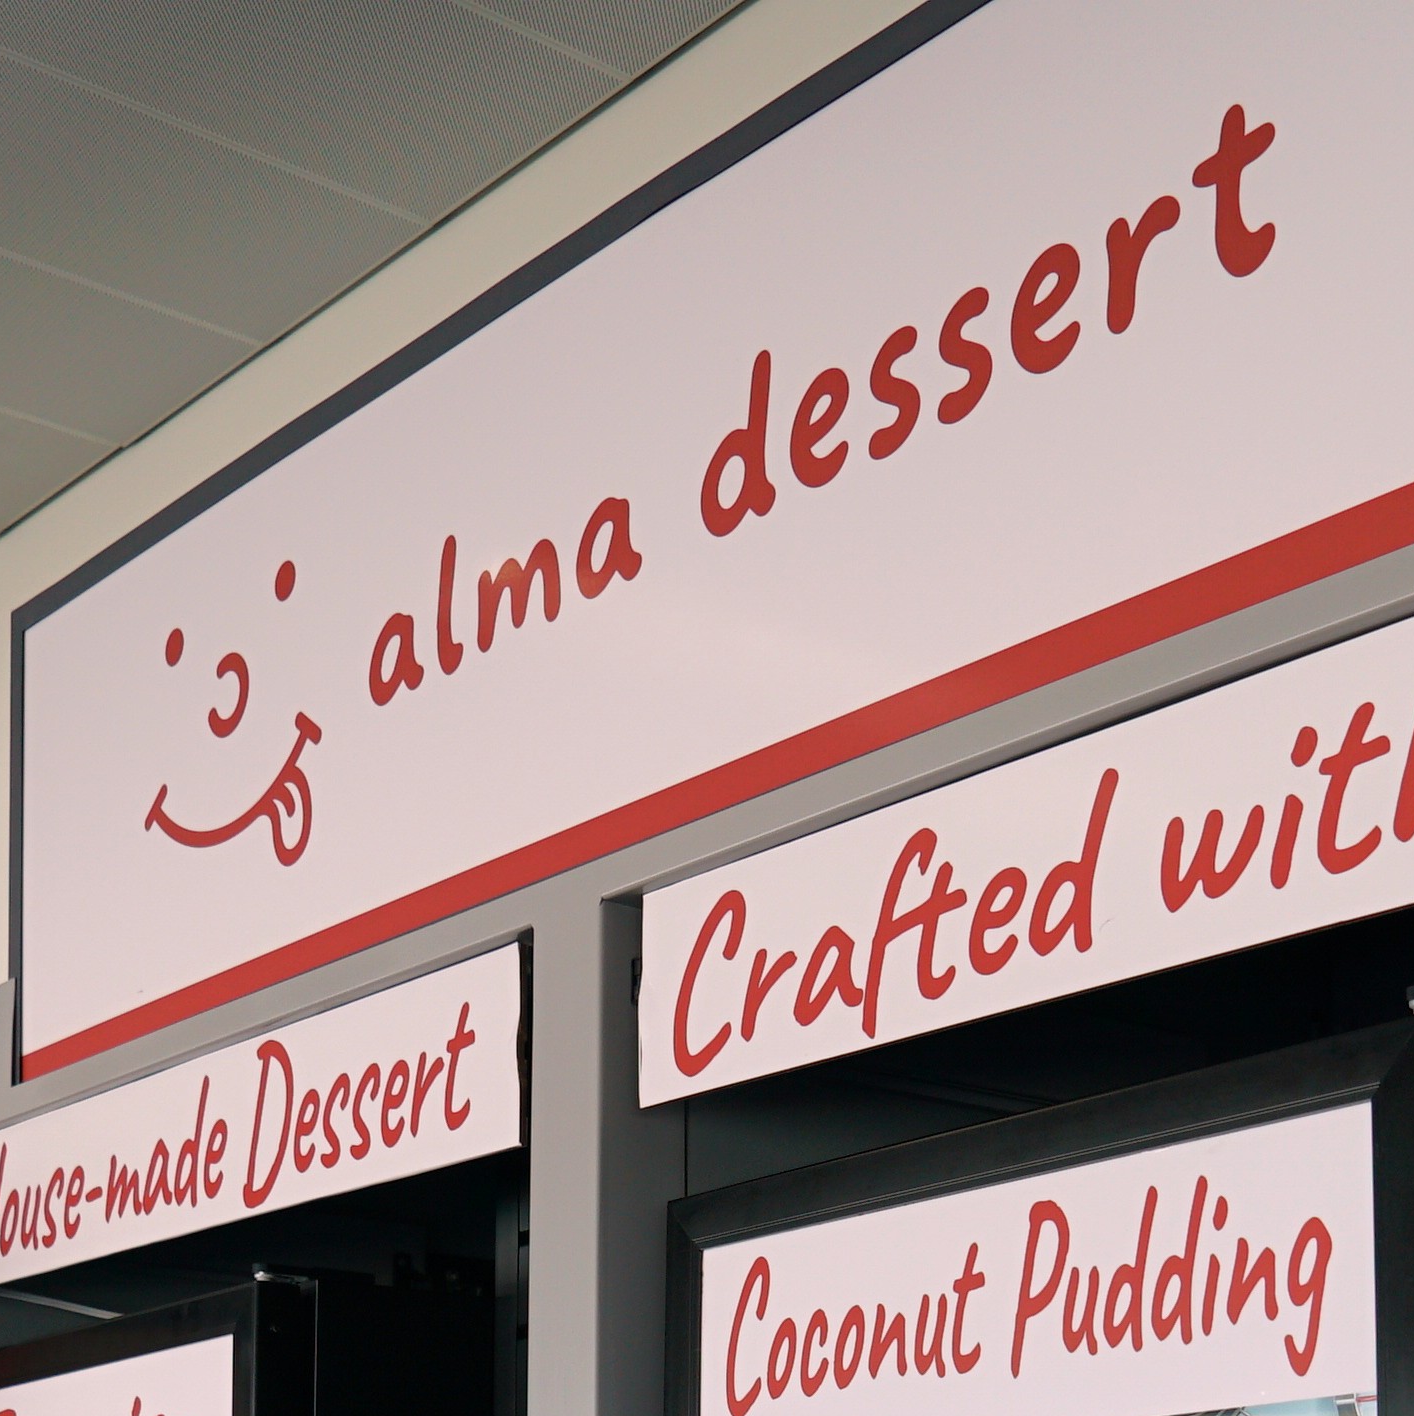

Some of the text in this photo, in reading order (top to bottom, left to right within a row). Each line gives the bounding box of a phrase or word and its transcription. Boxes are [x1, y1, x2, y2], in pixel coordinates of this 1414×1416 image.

[368, 104, 1276, 706] alma dessert
[673, 767, 1118, 1077] Crafted
[242, 1002, 475, 1208] Dessert
[1011, 1175, 1332, 1377] Pudding
